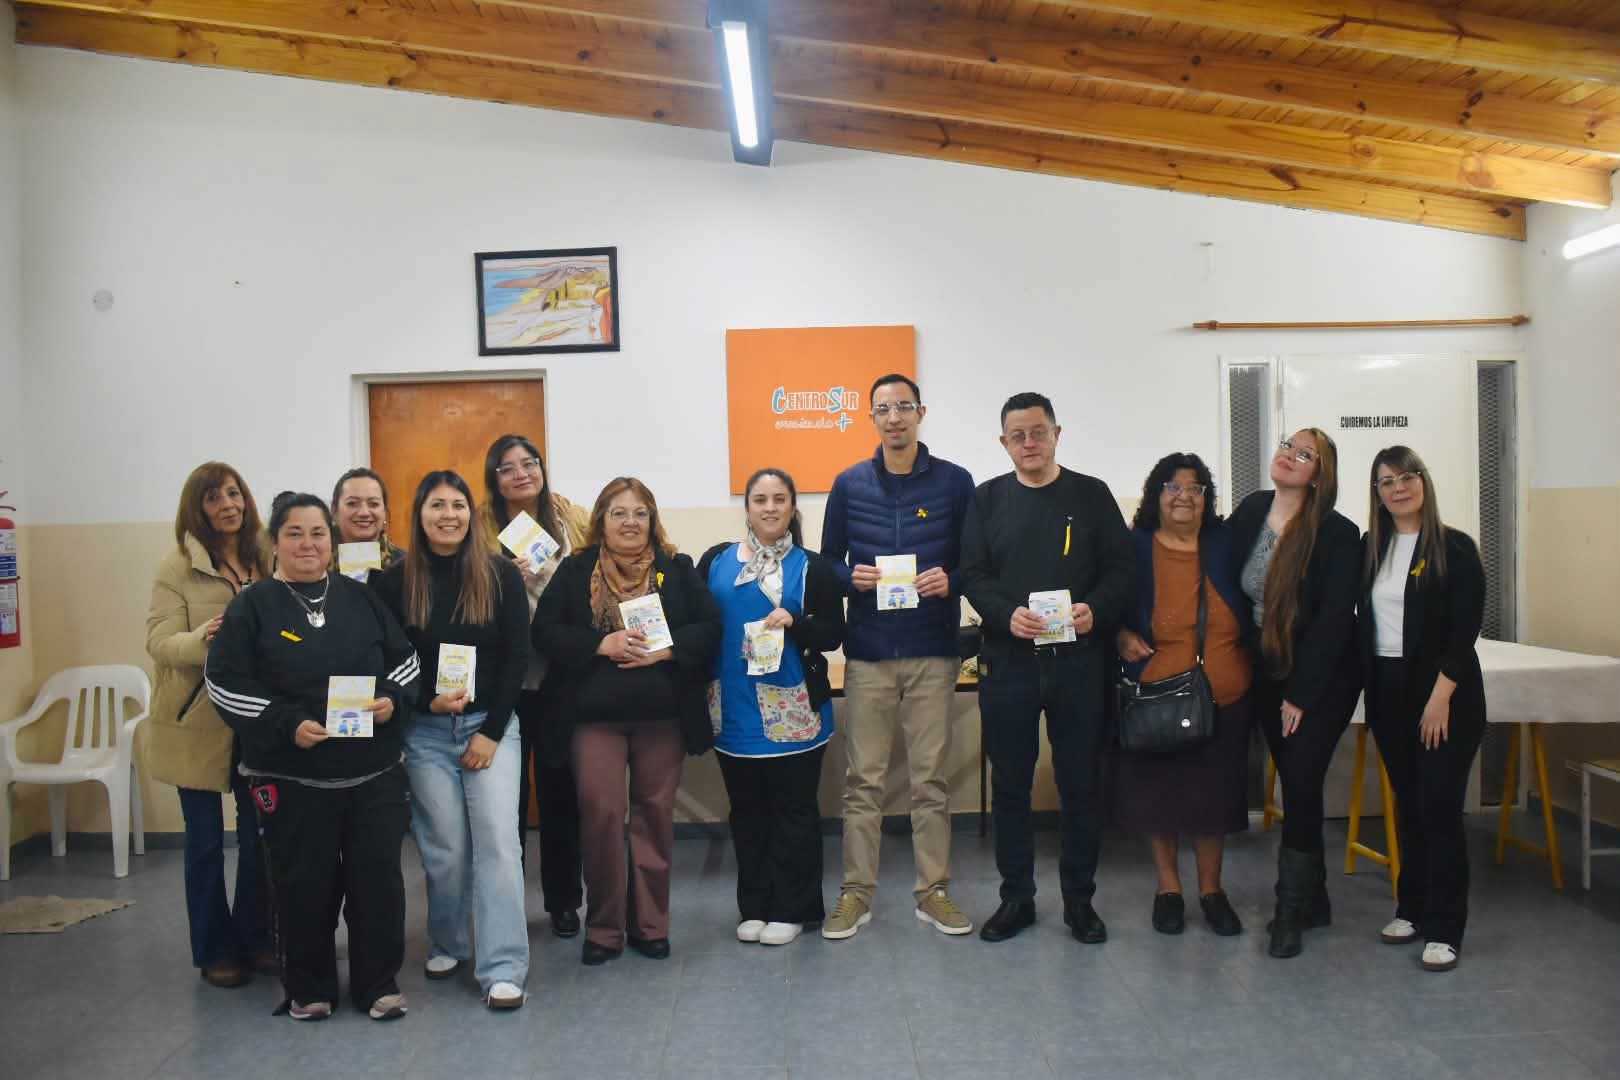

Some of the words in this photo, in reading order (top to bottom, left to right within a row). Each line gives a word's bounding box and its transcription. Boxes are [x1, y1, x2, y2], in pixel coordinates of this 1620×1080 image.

[1340, 416, 1372, 428] CUIDEMOS
[1373, 416, 1380, 427] LA
[1381, 416, 1408, 427] LIMPIEZA
